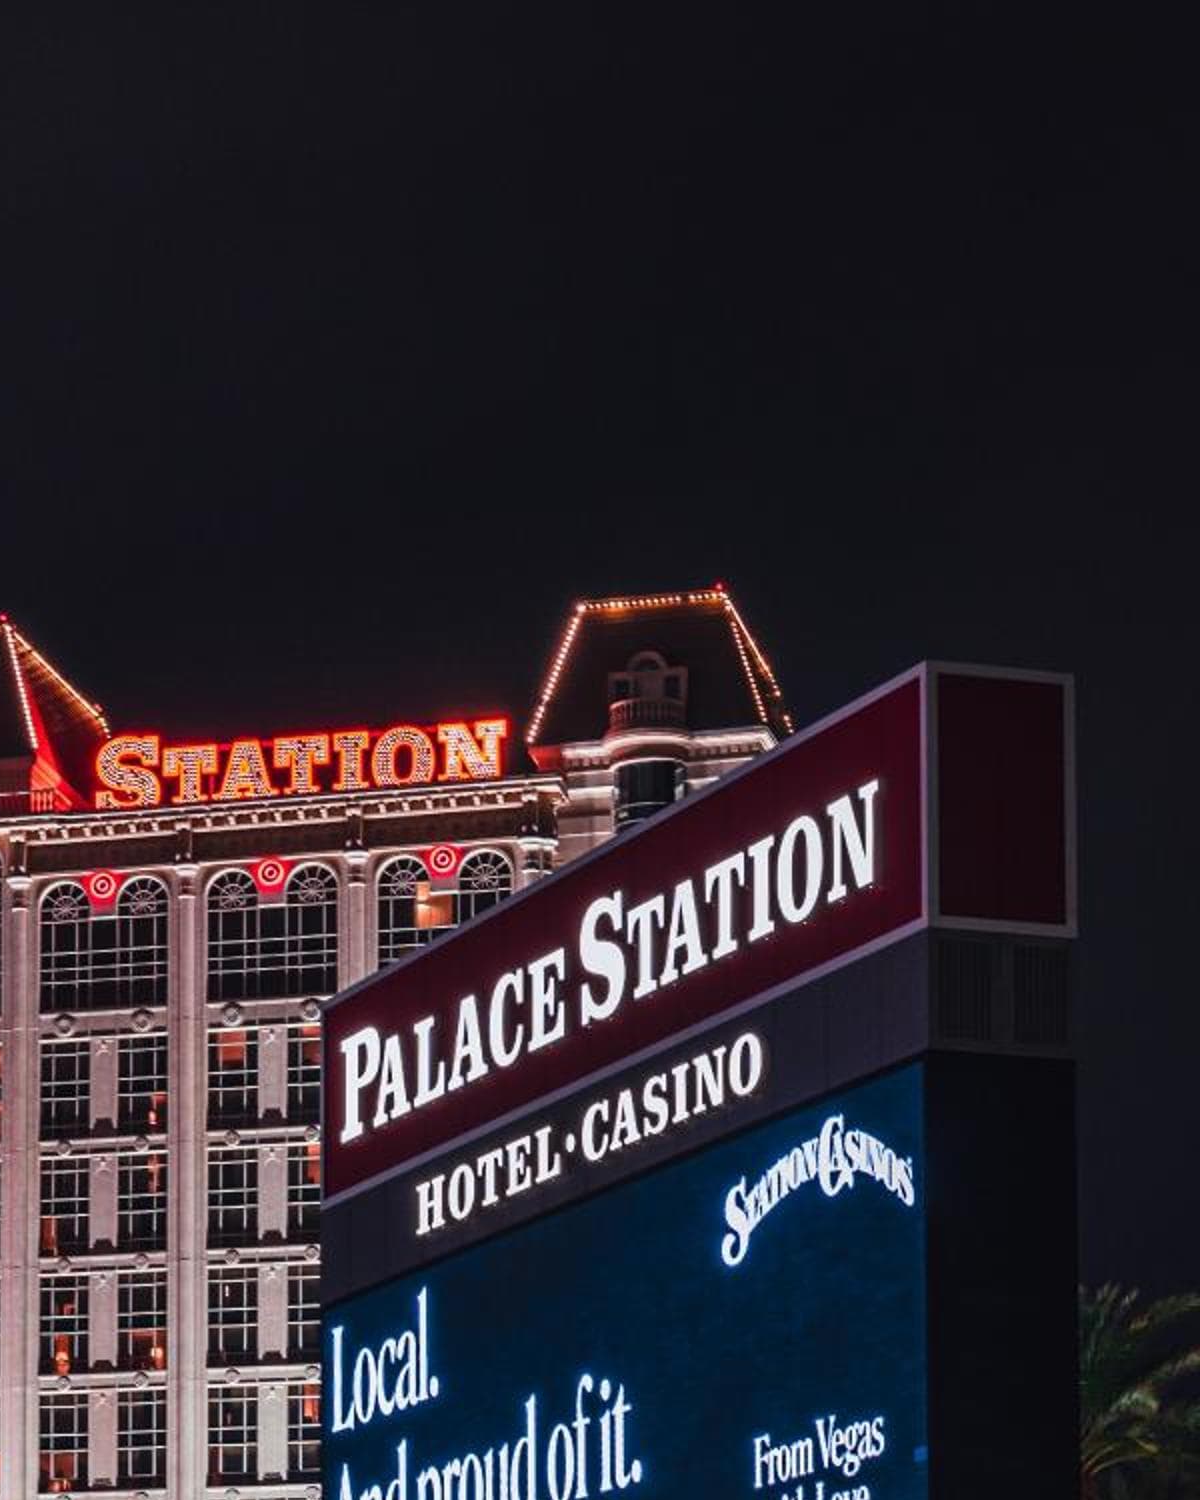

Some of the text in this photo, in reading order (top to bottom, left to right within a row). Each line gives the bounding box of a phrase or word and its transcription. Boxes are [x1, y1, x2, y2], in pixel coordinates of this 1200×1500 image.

[95, 719, 508, 808] STATION
[340, 779, 879, 1144] PALACE STATION
[415, 1033, 763, 1235] HOTEL CASINO
[721, 1113, 915, 1267] STATION CASINOS
[331, 1286, 439, 1433] Local.
[599, 1379, 643, 1492] it.
[753, 1414, 885, 1489] From Vegas
